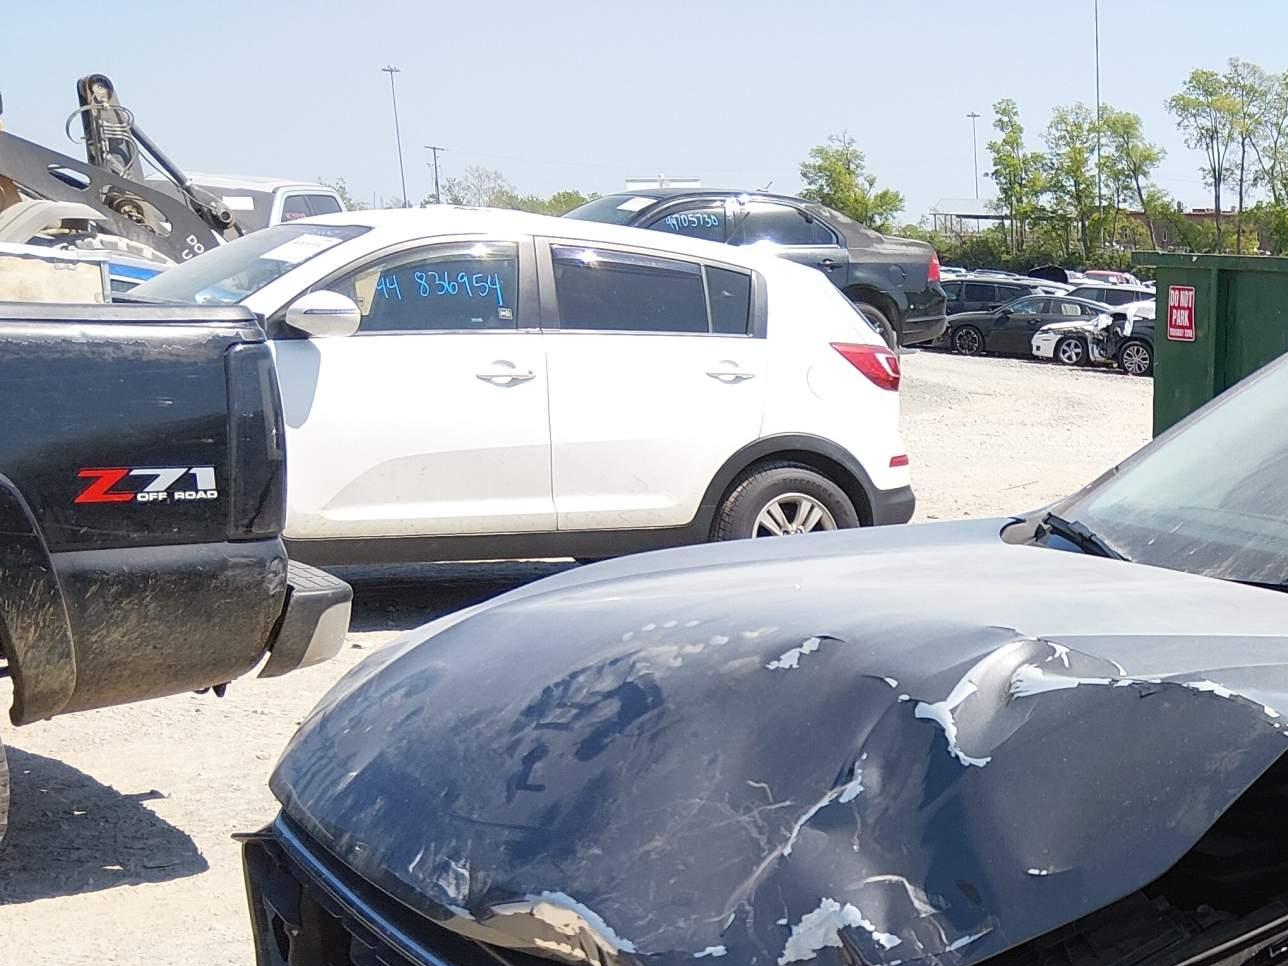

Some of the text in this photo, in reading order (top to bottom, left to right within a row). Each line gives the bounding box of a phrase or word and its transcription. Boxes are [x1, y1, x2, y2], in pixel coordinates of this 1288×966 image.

[376, 271, 504, 306] 44 836954
[1170, 290, 1193, 308] DO NOT
[1172, 309, 1190, 327] PARK
[74, 466, 217, 503] Z71
[136, 490, 218, 502] OFF ROAD
